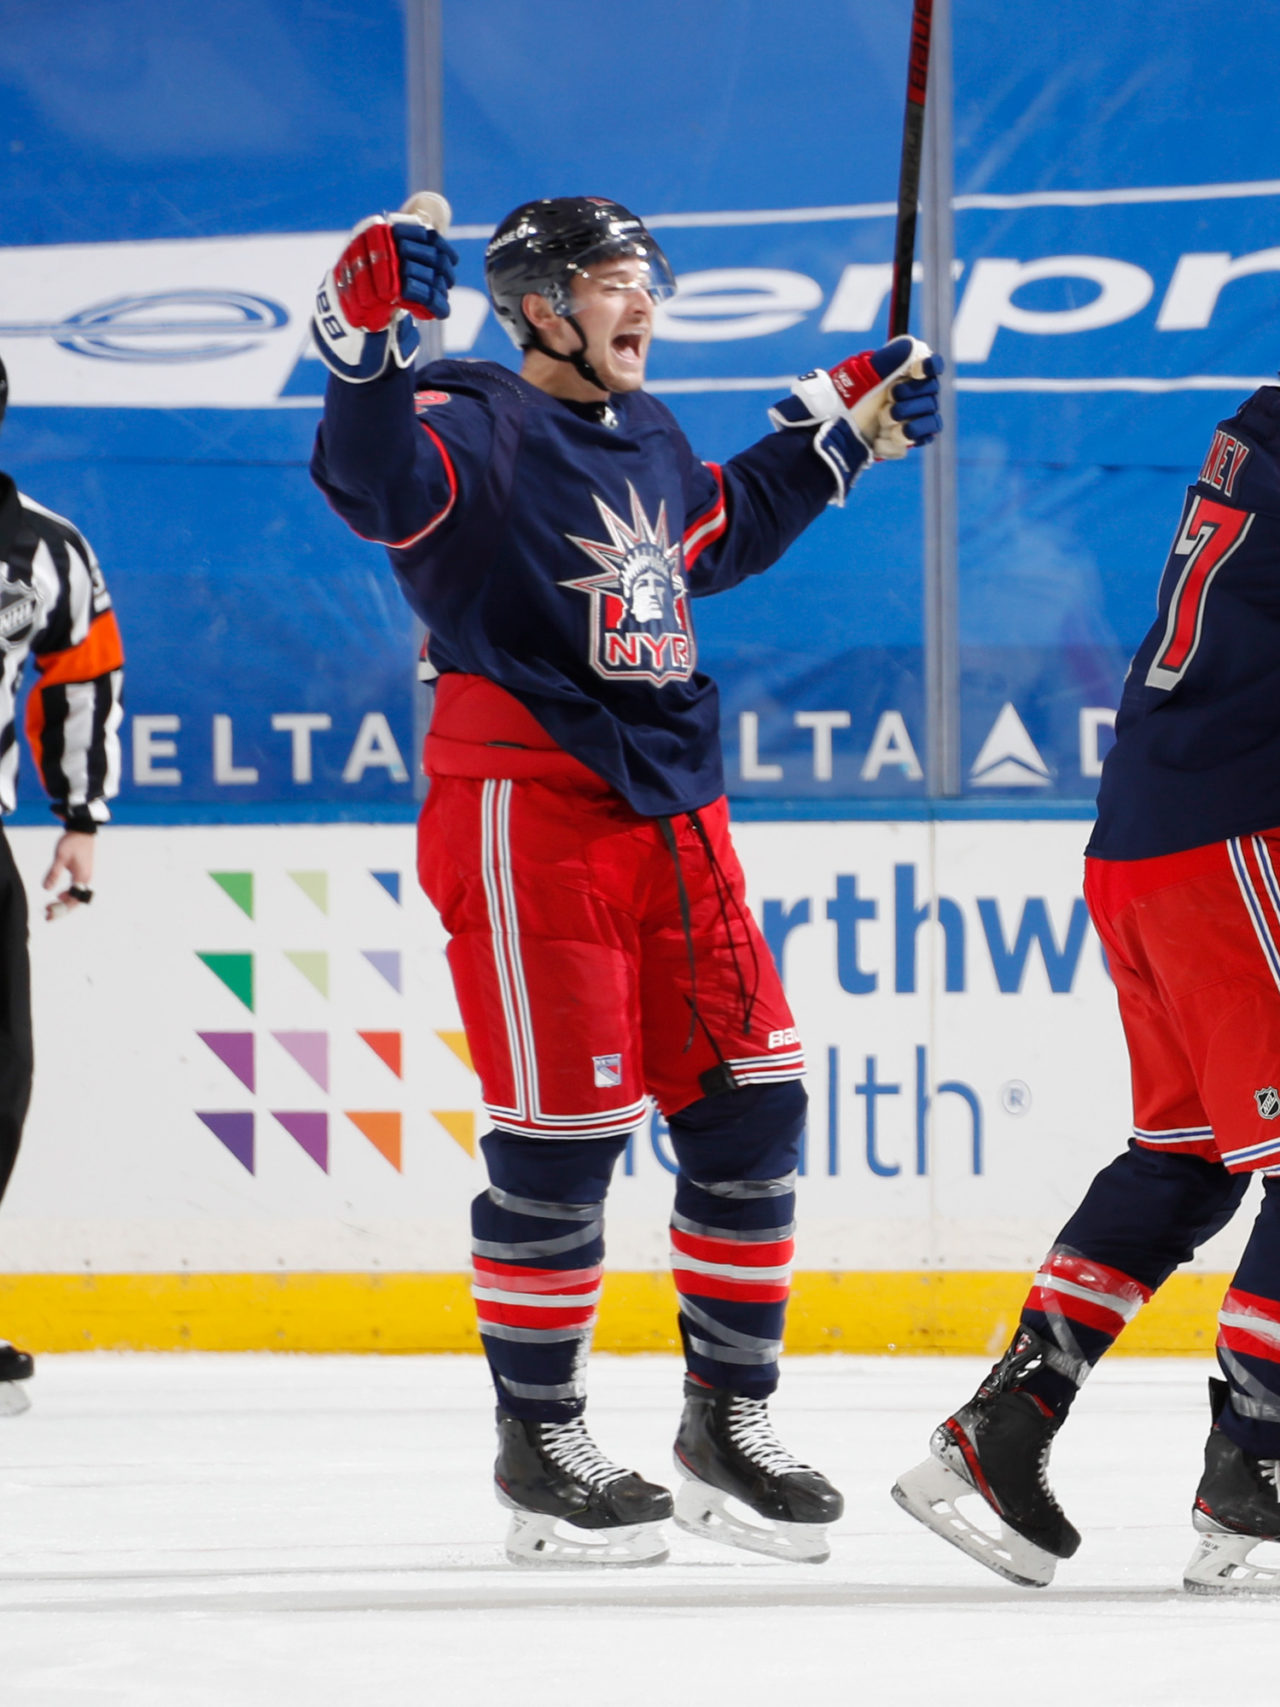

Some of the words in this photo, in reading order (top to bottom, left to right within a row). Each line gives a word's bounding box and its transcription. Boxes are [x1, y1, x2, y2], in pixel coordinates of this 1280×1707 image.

[1199, 429, 1250, 498] NEY
[1143, 494, 1256, 692] 7
[605, 632, 691, 669] NYR
[132, 713, 410, 786] ELTA
[738, 709, 925, 782] LTA
